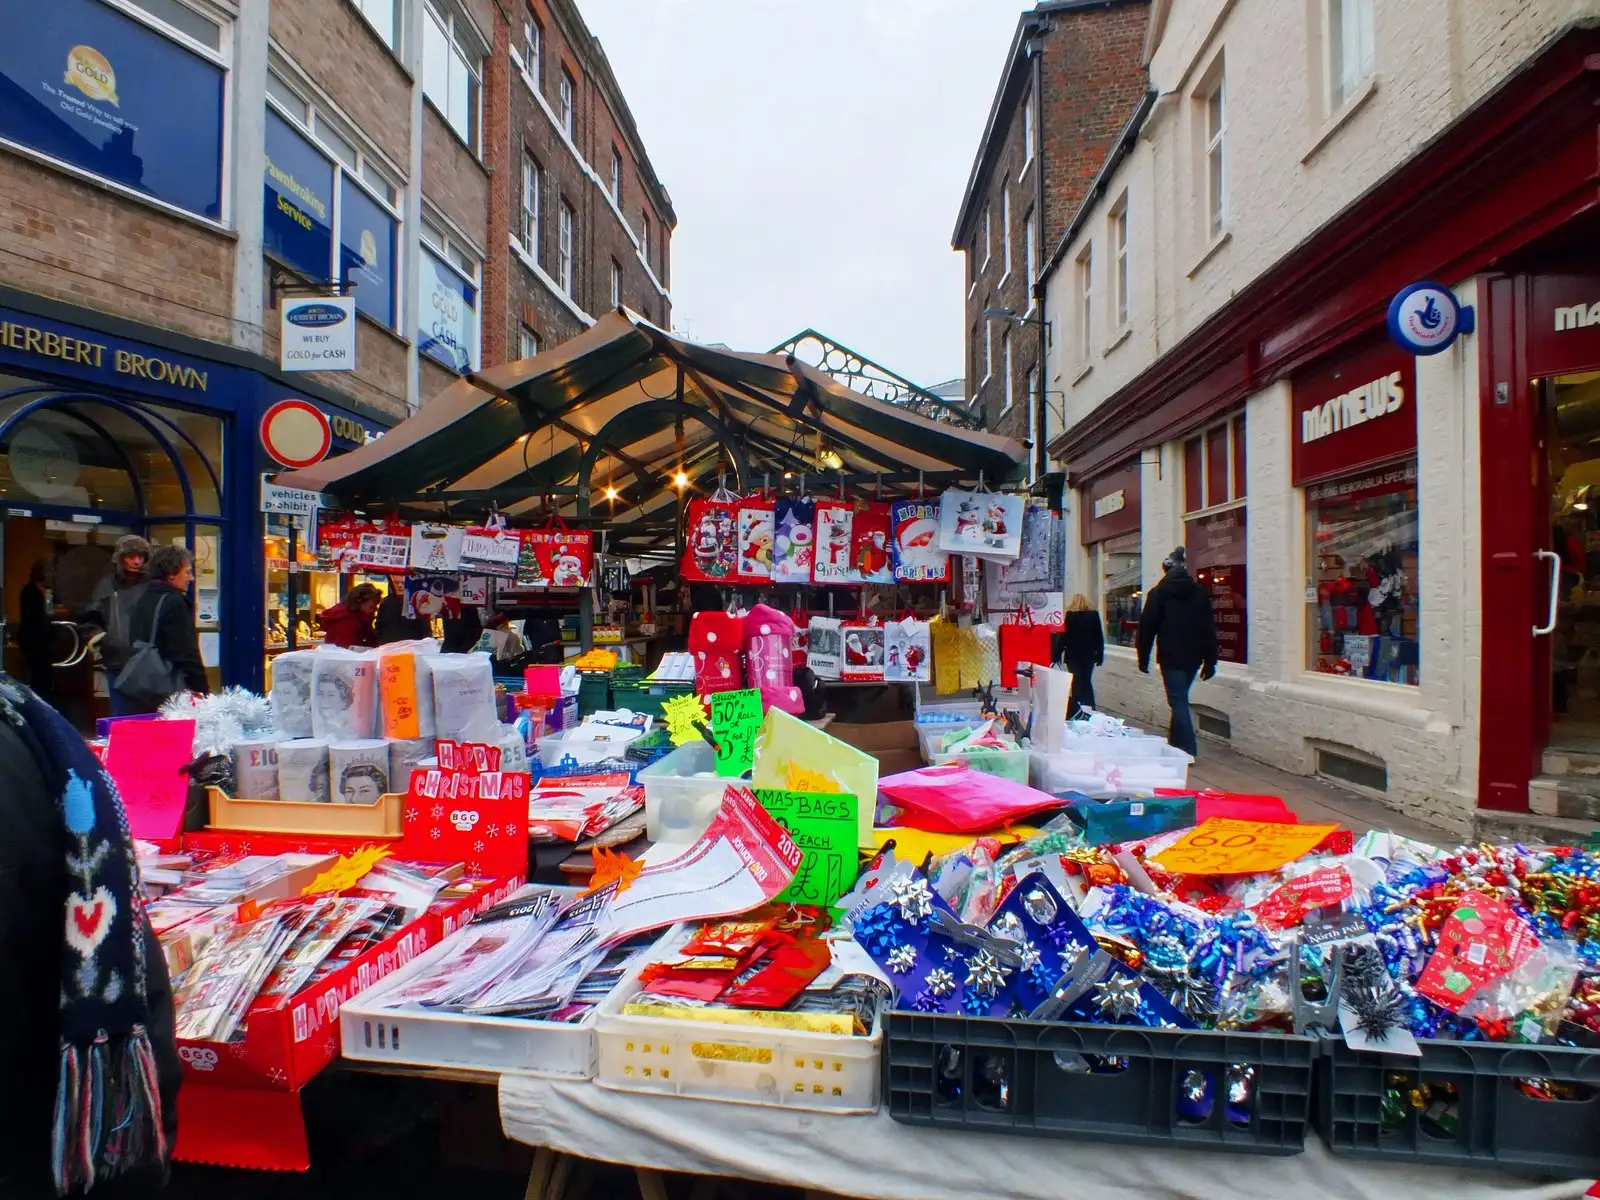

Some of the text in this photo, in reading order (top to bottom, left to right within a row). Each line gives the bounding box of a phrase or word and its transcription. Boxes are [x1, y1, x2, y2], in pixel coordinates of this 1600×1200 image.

[76, 62, 109, 85] GOLD
[264, 156, 326, 219] Pawnbroking
[277, 192, 313, 232] Service
[303, 335, 330, 343] WE BUY
[432, 321, 457, 350] CASH
[287, 350, 311, 359] GOLD
[323, 350, 346, 358] CASH
[115, 350, 209, 392] BROWN
[1302, 371, 1405, 444] MAYNEWS
[332, 415, 365, 444] GOLD
[271, 490, 317, 501] vehicles
[895, 564, 946, 580] CHRISTMAS
[355, 667, 367, 677] 20
[730, 720, 740, 729] OR
[737, 712, 756, 720] ROLL
[503, 745, 522, 764] £5
[715, 729, 734, 761] 3
[732, 732, 743, 740] FOR
[250, 747, 279, 767] £10
[438, 742, 499, 772] HAPPY
[414, 770, 524, 801] CHRISTMAS
[740, 789, 757, 811] LARGE
[751, 789, 851, 818] XMAS BAGS
[776, 834, 802, 868] 2013
[800, 834, 831, 848] EACH
[732, 835, 757, 868] January
[752, 861, 768, 882] 013
[509, 904, 534, 916] 2013
[569, 903, 592, 917] 2013
[1308, 920, 1366, 944] North Pole
[350, 926, 429, 998] CHRISTMAS
